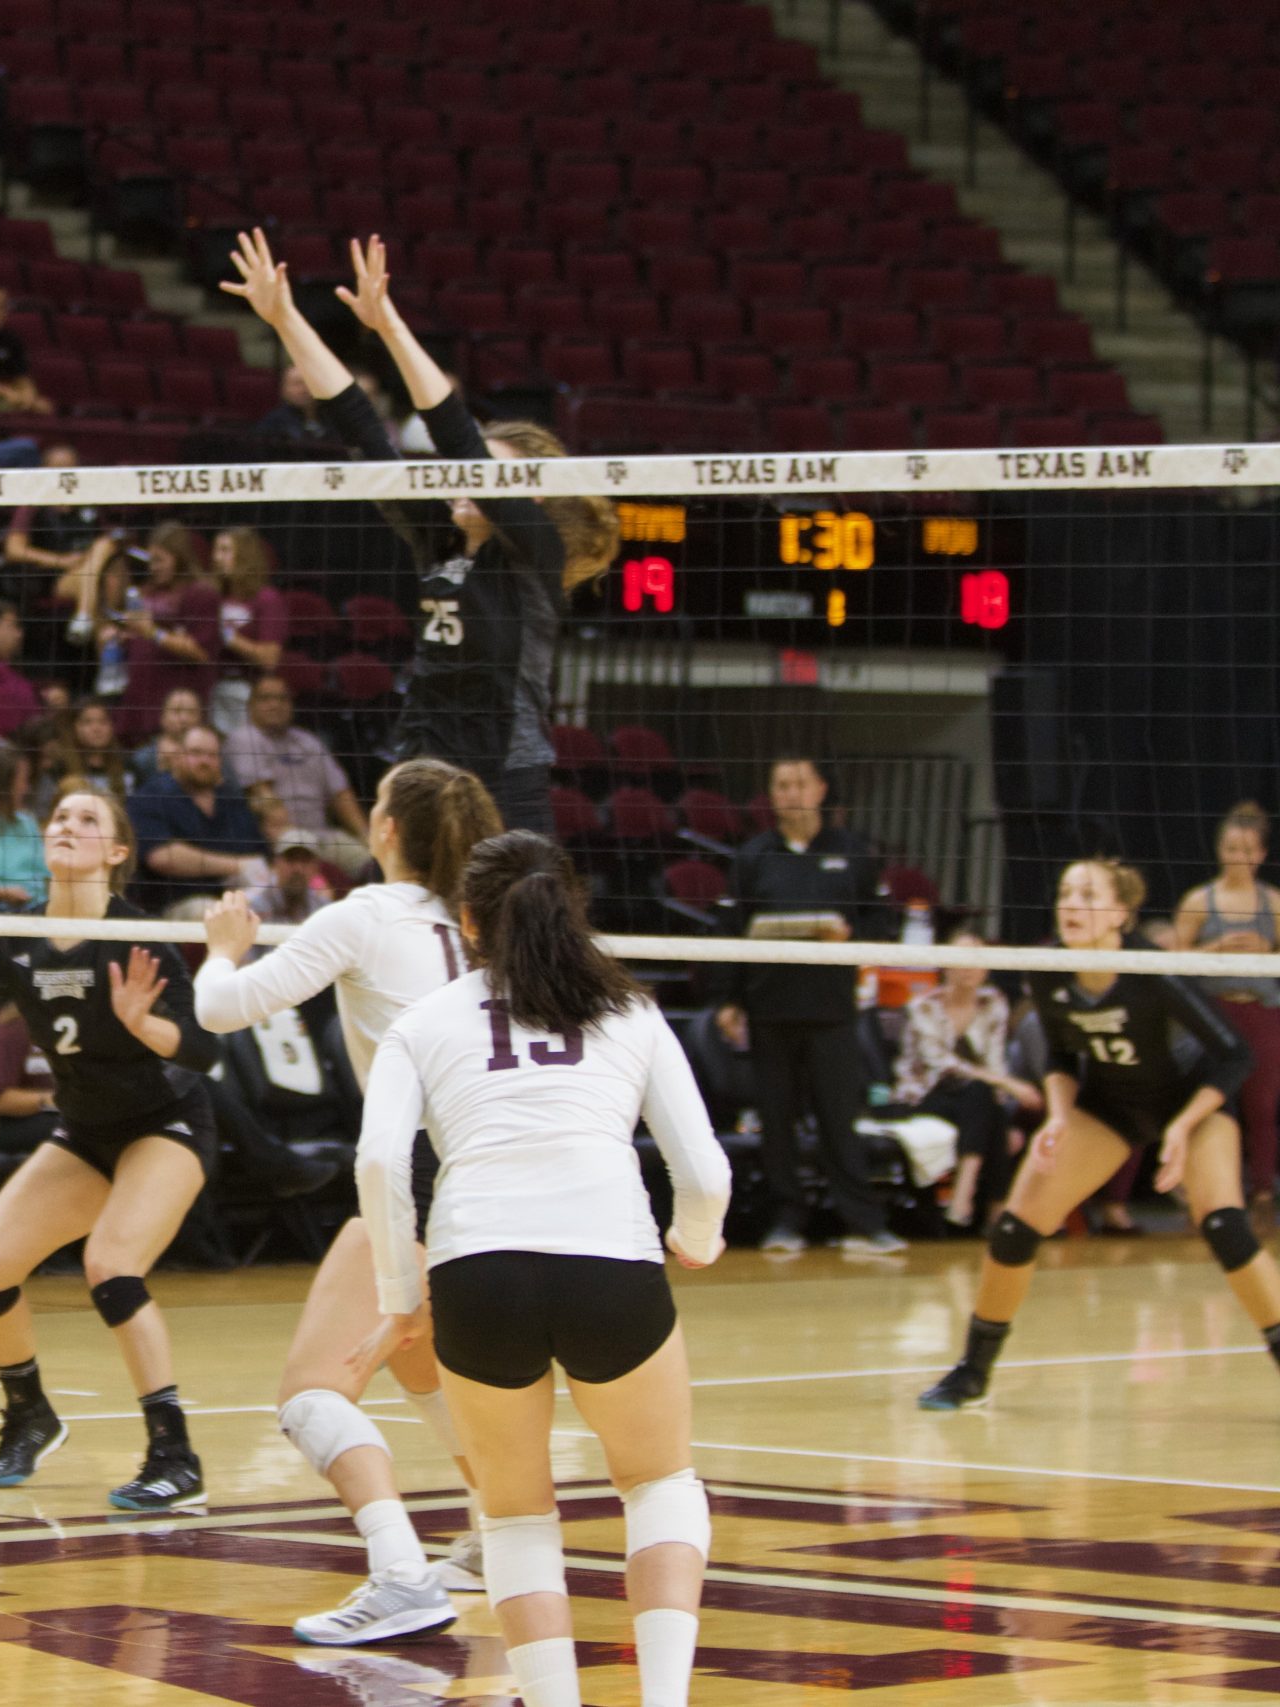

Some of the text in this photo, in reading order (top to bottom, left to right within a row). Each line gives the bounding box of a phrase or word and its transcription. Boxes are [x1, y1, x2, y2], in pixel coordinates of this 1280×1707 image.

[405, 461, 545, 490] TEXAS A&M
[693, 457, 837, 486] TEXAS A&M
[998, 450, 1153, 480] TEXAS A&M
[136, 468, 267, 495] TEXAS A&M
[420, 599, 464, 646] 25
[53, 1015, 82, 1056] 2
[1090, 1038, 1139, 1066] 12
